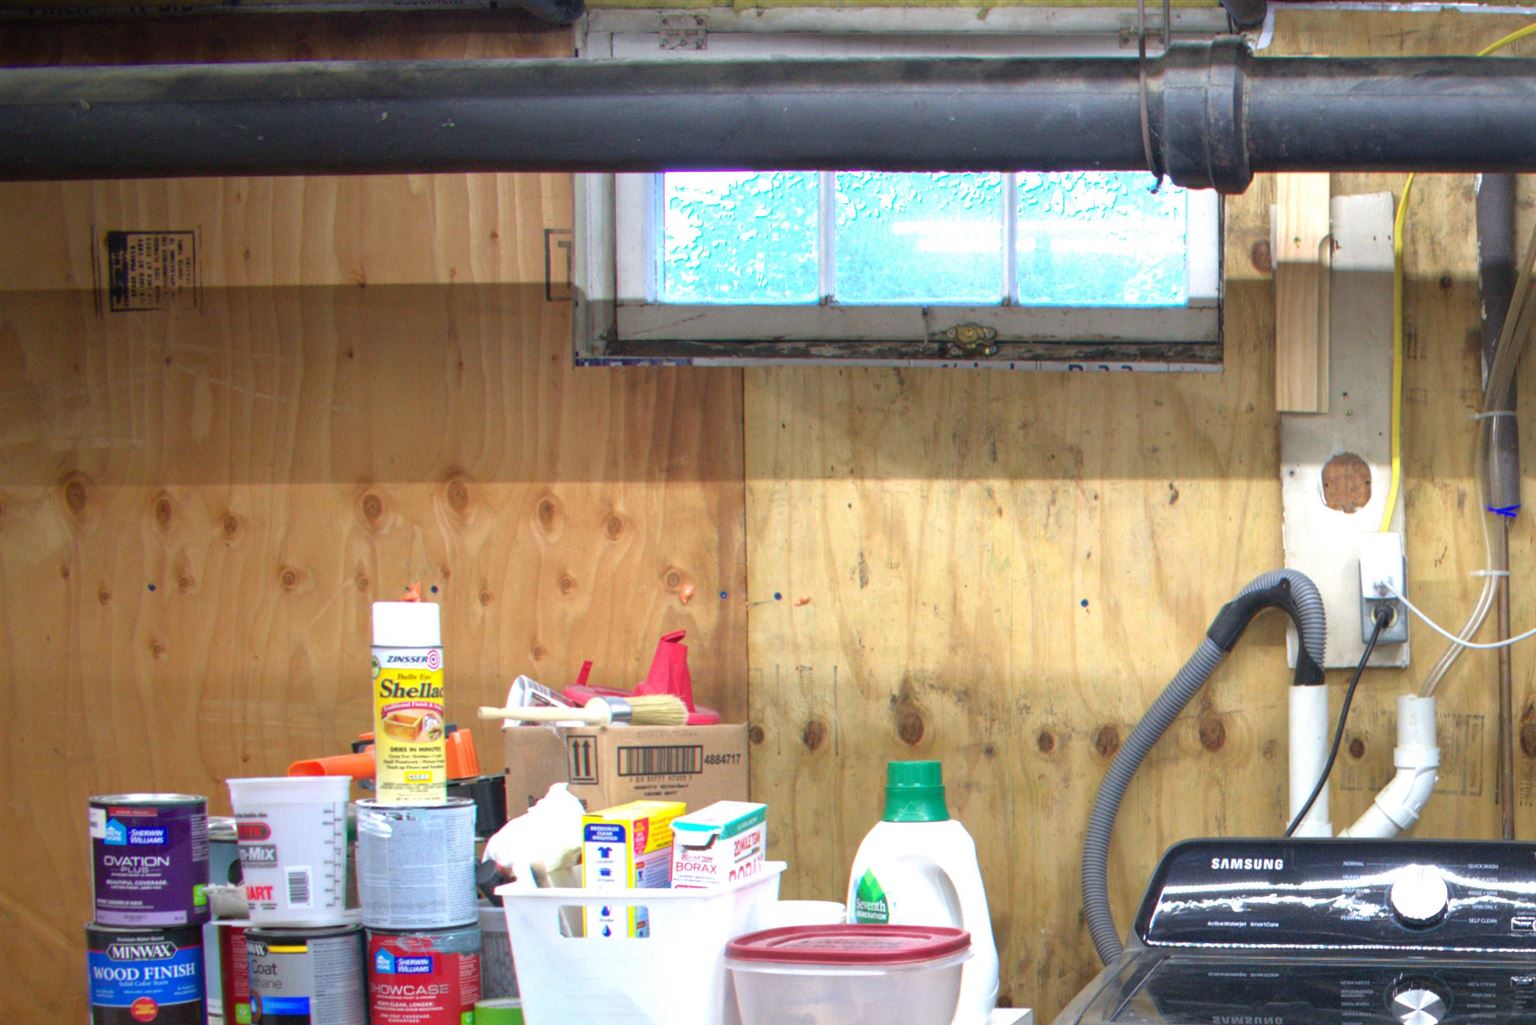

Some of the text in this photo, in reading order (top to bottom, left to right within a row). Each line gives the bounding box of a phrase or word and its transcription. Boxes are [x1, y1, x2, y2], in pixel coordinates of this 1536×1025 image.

[387, 655, 428, 664] ZINSSER
[704, 754, 741, 764] 4884717
[131, 836, 164, 844] WILLIAMS
[104, 856, 170, 867] OVATION
[1211, 858, 1284, 871] SAMSUNG
[676, 862, 717, 875] BORAX
[856, 900, 886, 913] Seventh
[857, 912, 887, 920] GENERATION
[112, 945, 172, 959] MINWAX
[92, 963, 195, 980] WOOD FINISH
